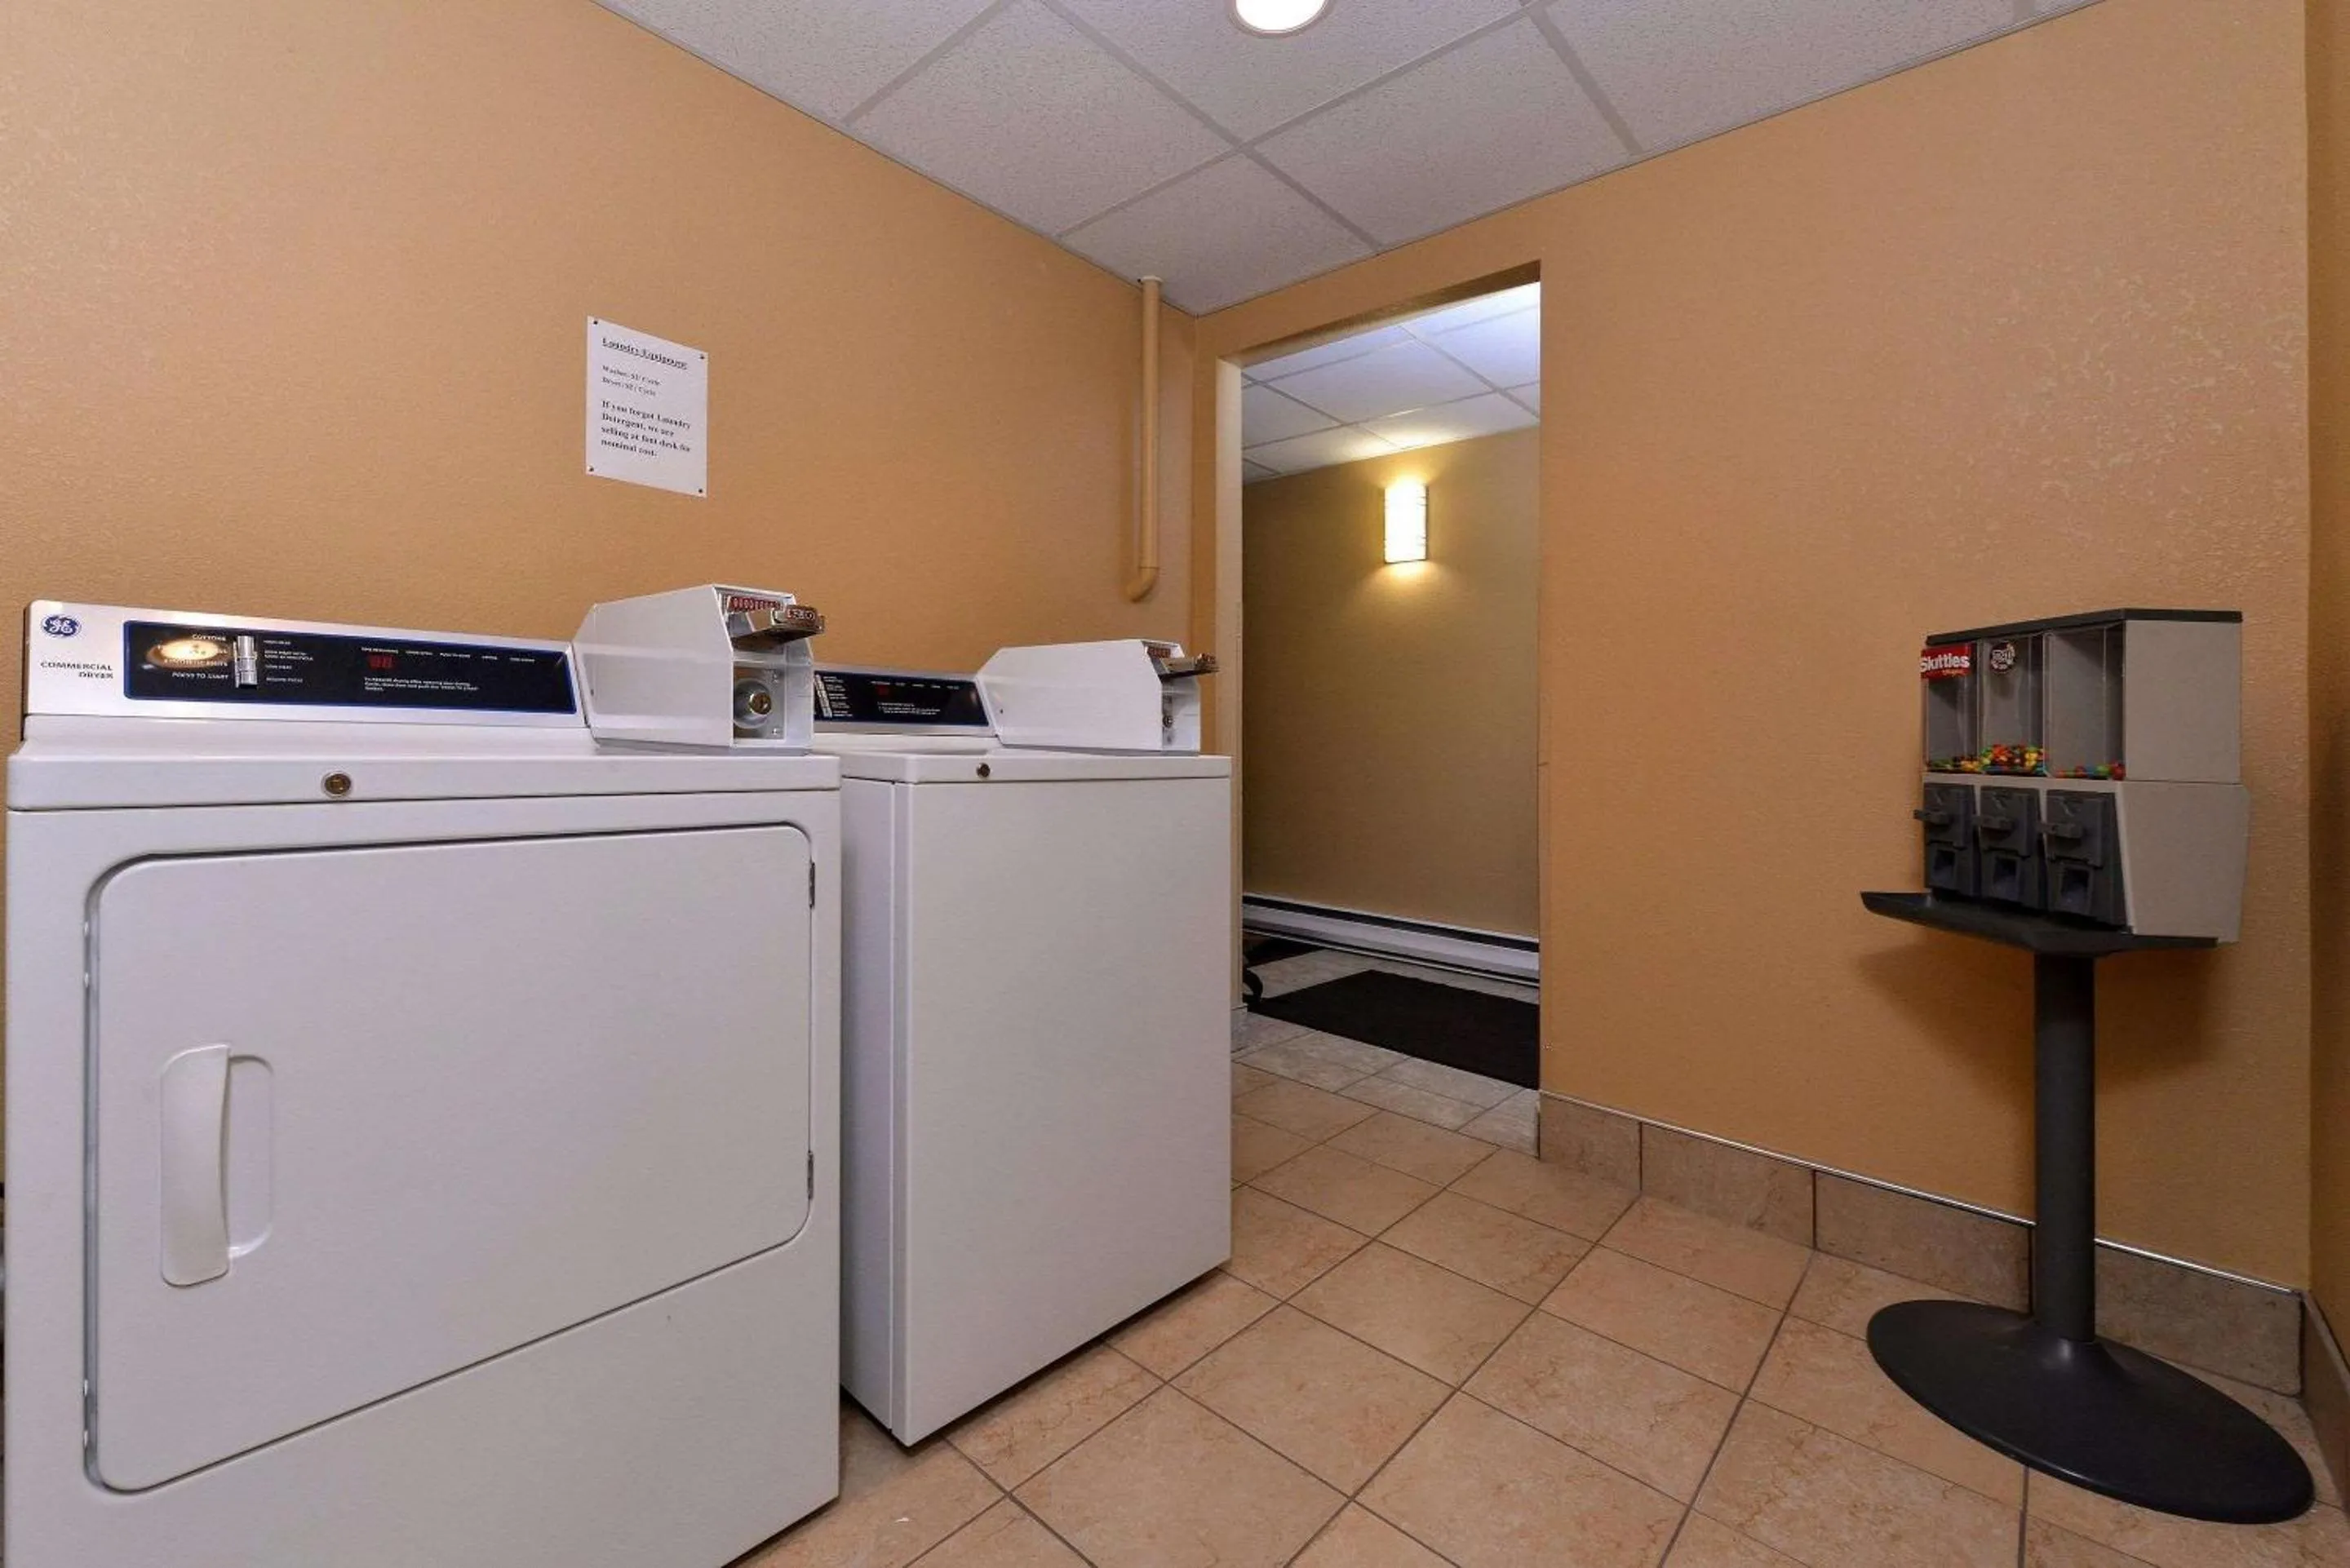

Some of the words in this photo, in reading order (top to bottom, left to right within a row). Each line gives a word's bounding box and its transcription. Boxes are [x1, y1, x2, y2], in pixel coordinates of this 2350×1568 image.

[602, 400, 610, 408] If
[611, 405, 627, 413] you
[629, 407, 654, 419] forget
[657, 414, 690, 430] Laundry
[45, 616, 77, 636] GE
[41, 662, 113, 671] COMMERCIAL
[1920, 653, 1971, 671] Skittles
[79, 671, 113, 679] DRYER
